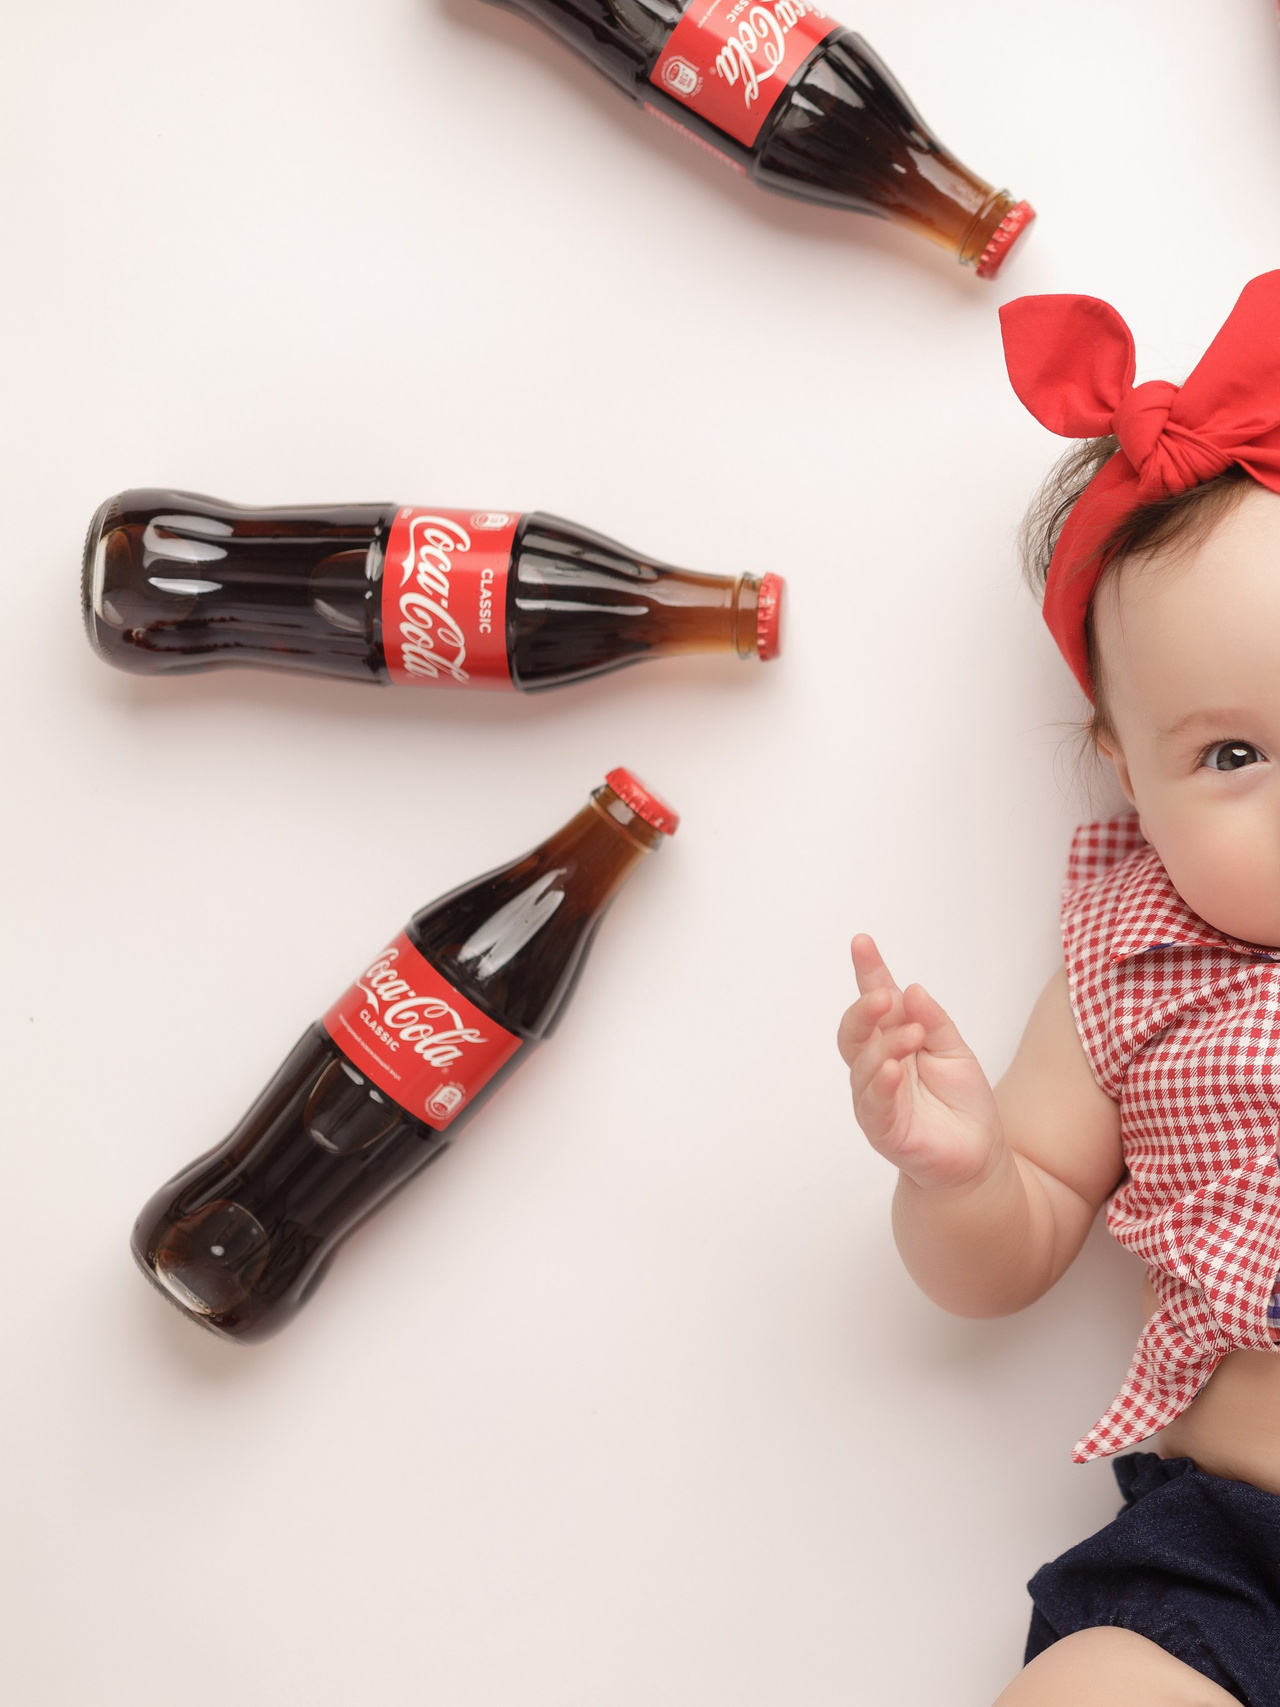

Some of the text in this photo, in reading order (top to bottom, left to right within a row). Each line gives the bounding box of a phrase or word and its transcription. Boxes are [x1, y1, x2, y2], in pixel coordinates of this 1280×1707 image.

[715, 0, 826, 110] ca-Cola
[726, 0, 750, 23] SSIC
[400, 516, 471, 685] Coca-Cola
[479, 568, 494, 634] CLASSIC
[356, 947, 488, 1067] Coca-Cola
[359, 1009, 400, 1052] CLASSIC
